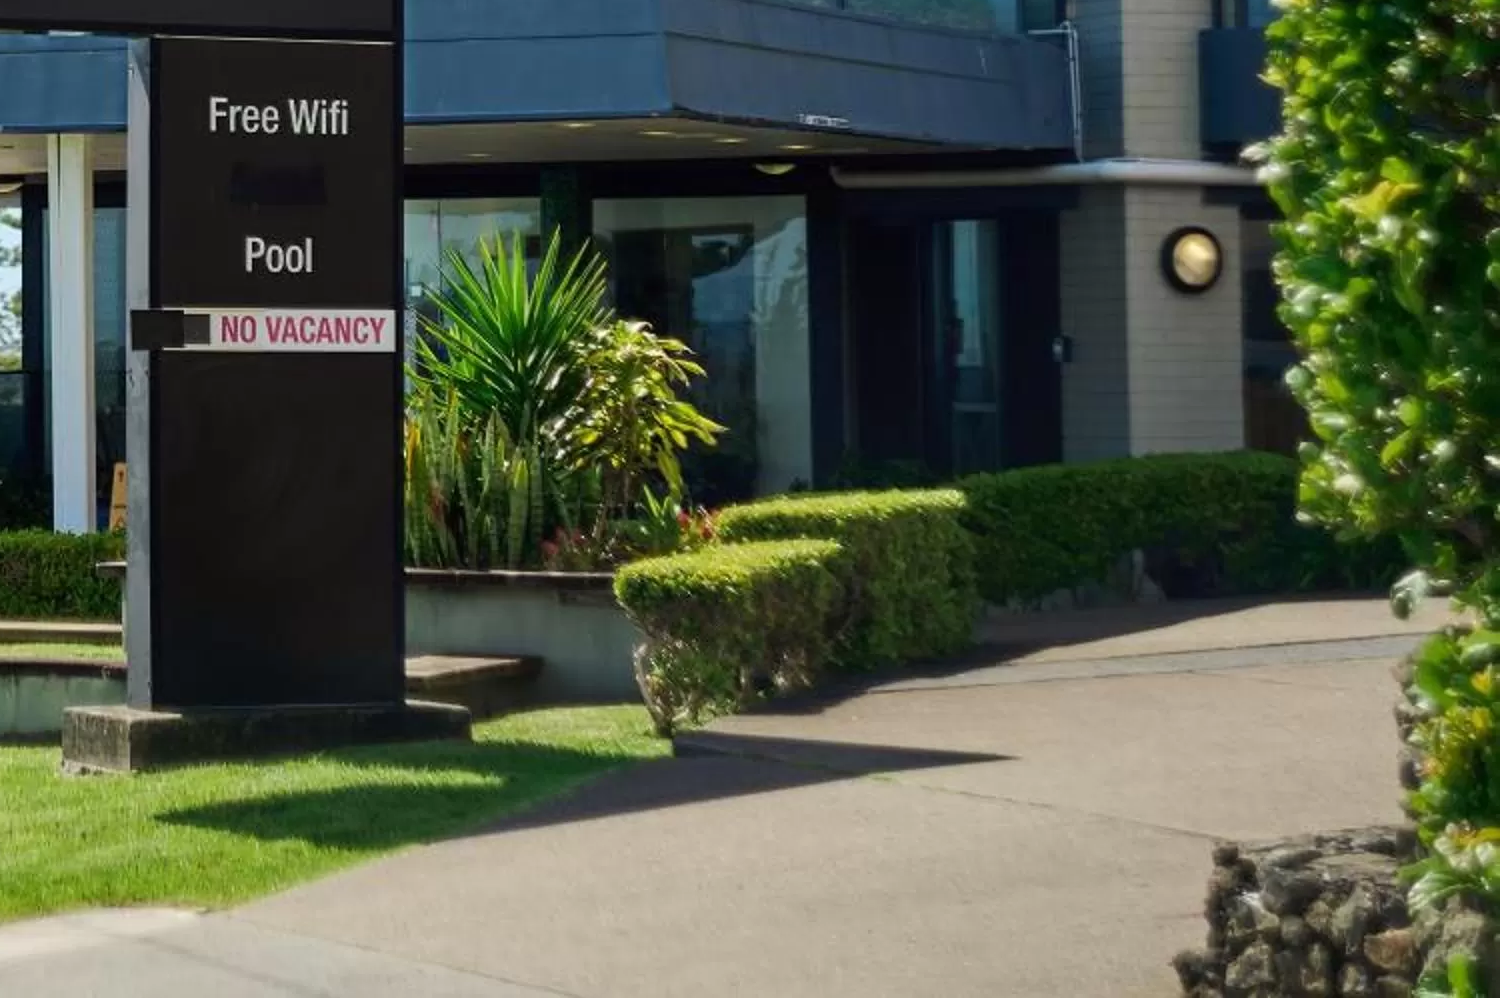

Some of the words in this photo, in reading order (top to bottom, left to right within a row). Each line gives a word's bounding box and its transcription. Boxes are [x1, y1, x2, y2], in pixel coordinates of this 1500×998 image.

[209, 96, 280, 134] Free
[287, 98, 348, 135] Wifi
[245, 236, 313, 273] Pool
[221, 315, 257, 343] NO
[264, 316, 387, 345] VACANCY
